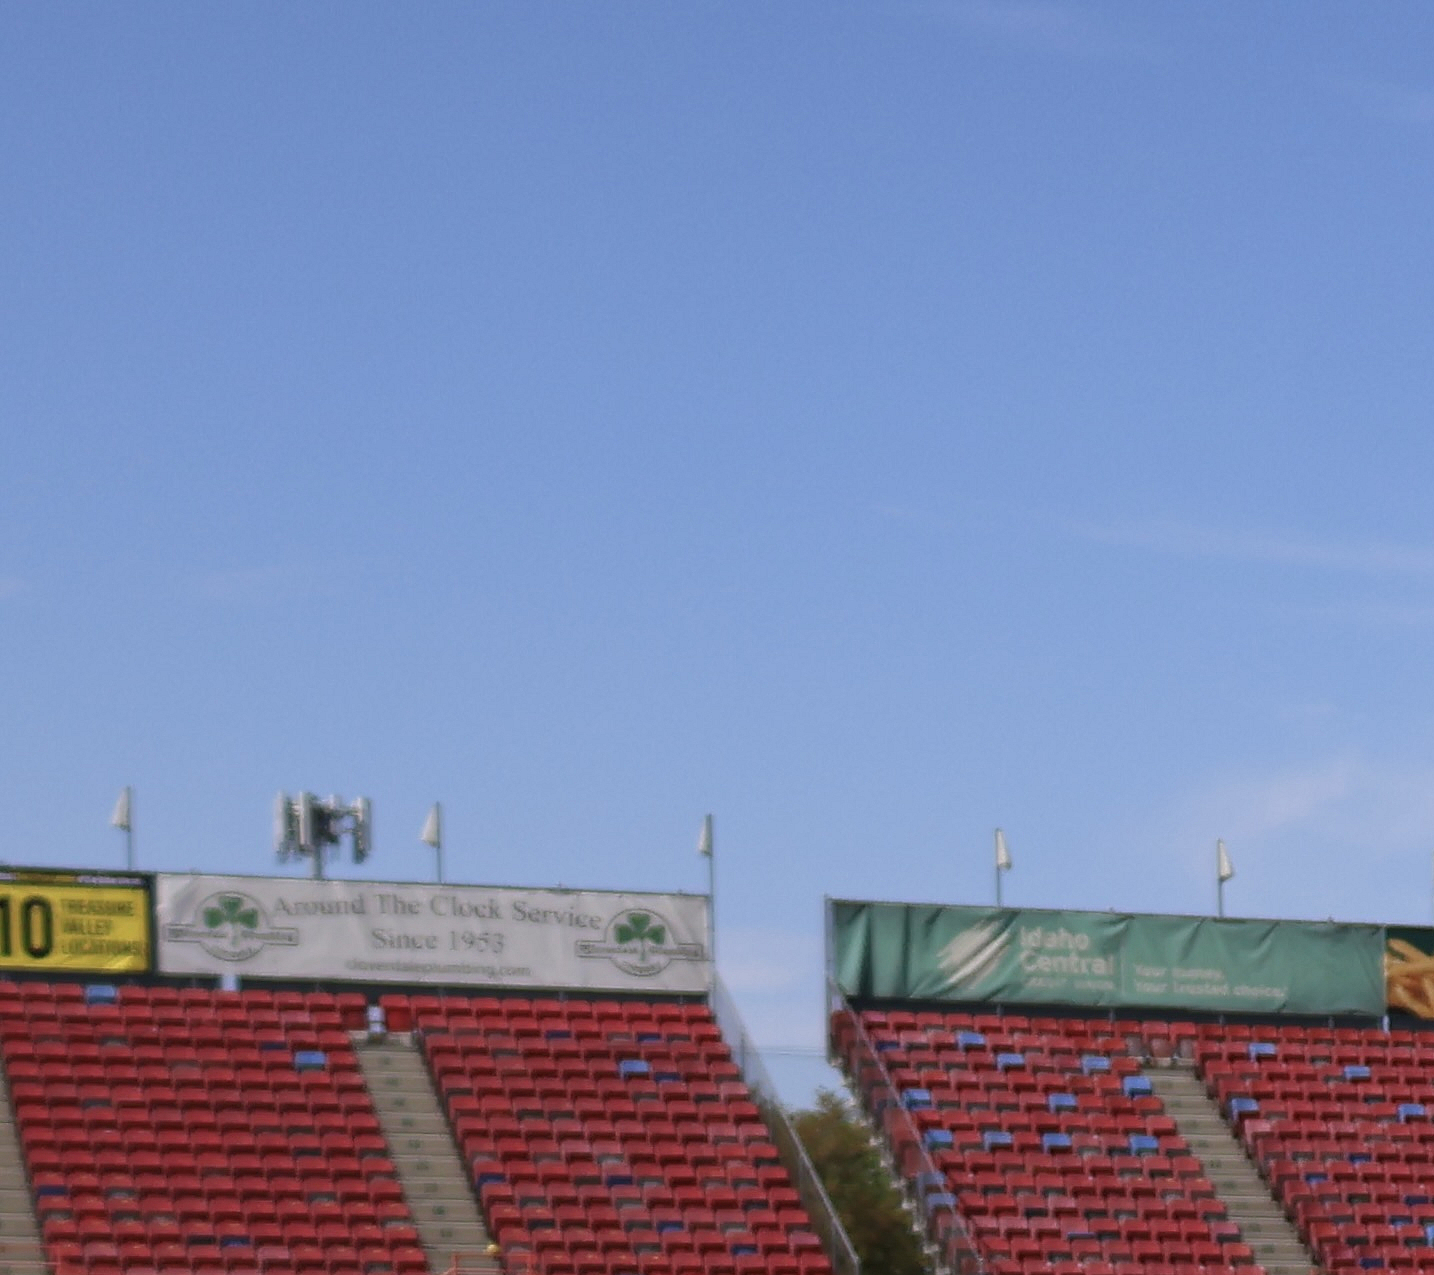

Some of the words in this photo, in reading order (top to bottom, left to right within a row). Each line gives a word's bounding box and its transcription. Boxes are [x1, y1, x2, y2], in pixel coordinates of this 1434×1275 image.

[275, 893, 366, 916] Around
[373, 893, 421, 916] The
[430, 894, 503, 919] Clock
[512, 900, 601, 930] Service
[372, 927, 438, 950] Since
[450, 930, 504, 953] 1953
[1020, 926, 1089, 950] Idaho
[1019, 951, 1114, 977] Central
